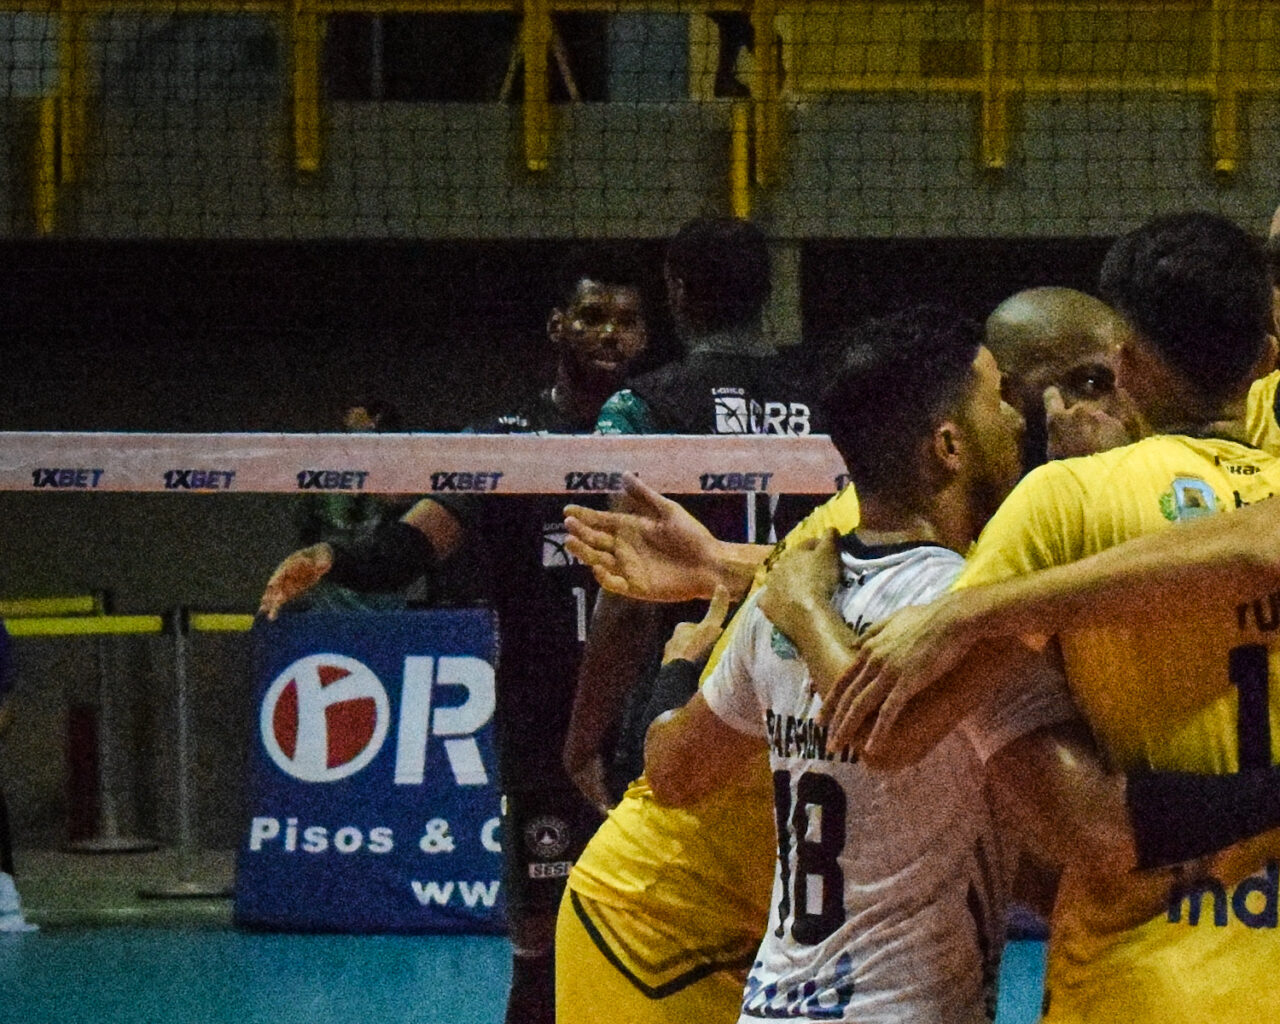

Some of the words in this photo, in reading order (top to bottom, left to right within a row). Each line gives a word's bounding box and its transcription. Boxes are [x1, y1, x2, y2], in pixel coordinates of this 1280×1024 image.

[32, 468, 104, 488] 1XBET
[164, 470, 236, 489] 1XBET
[296, 470, 369, 489] 1XBET
[430, 472, 503, 491] 1XBET
[565, 472, 639, 491] 1XBE
[700, 472, 774, 491] 1XBET
[249, 816, 394, 853] Pisos
[419, 818, 456, 853] &
